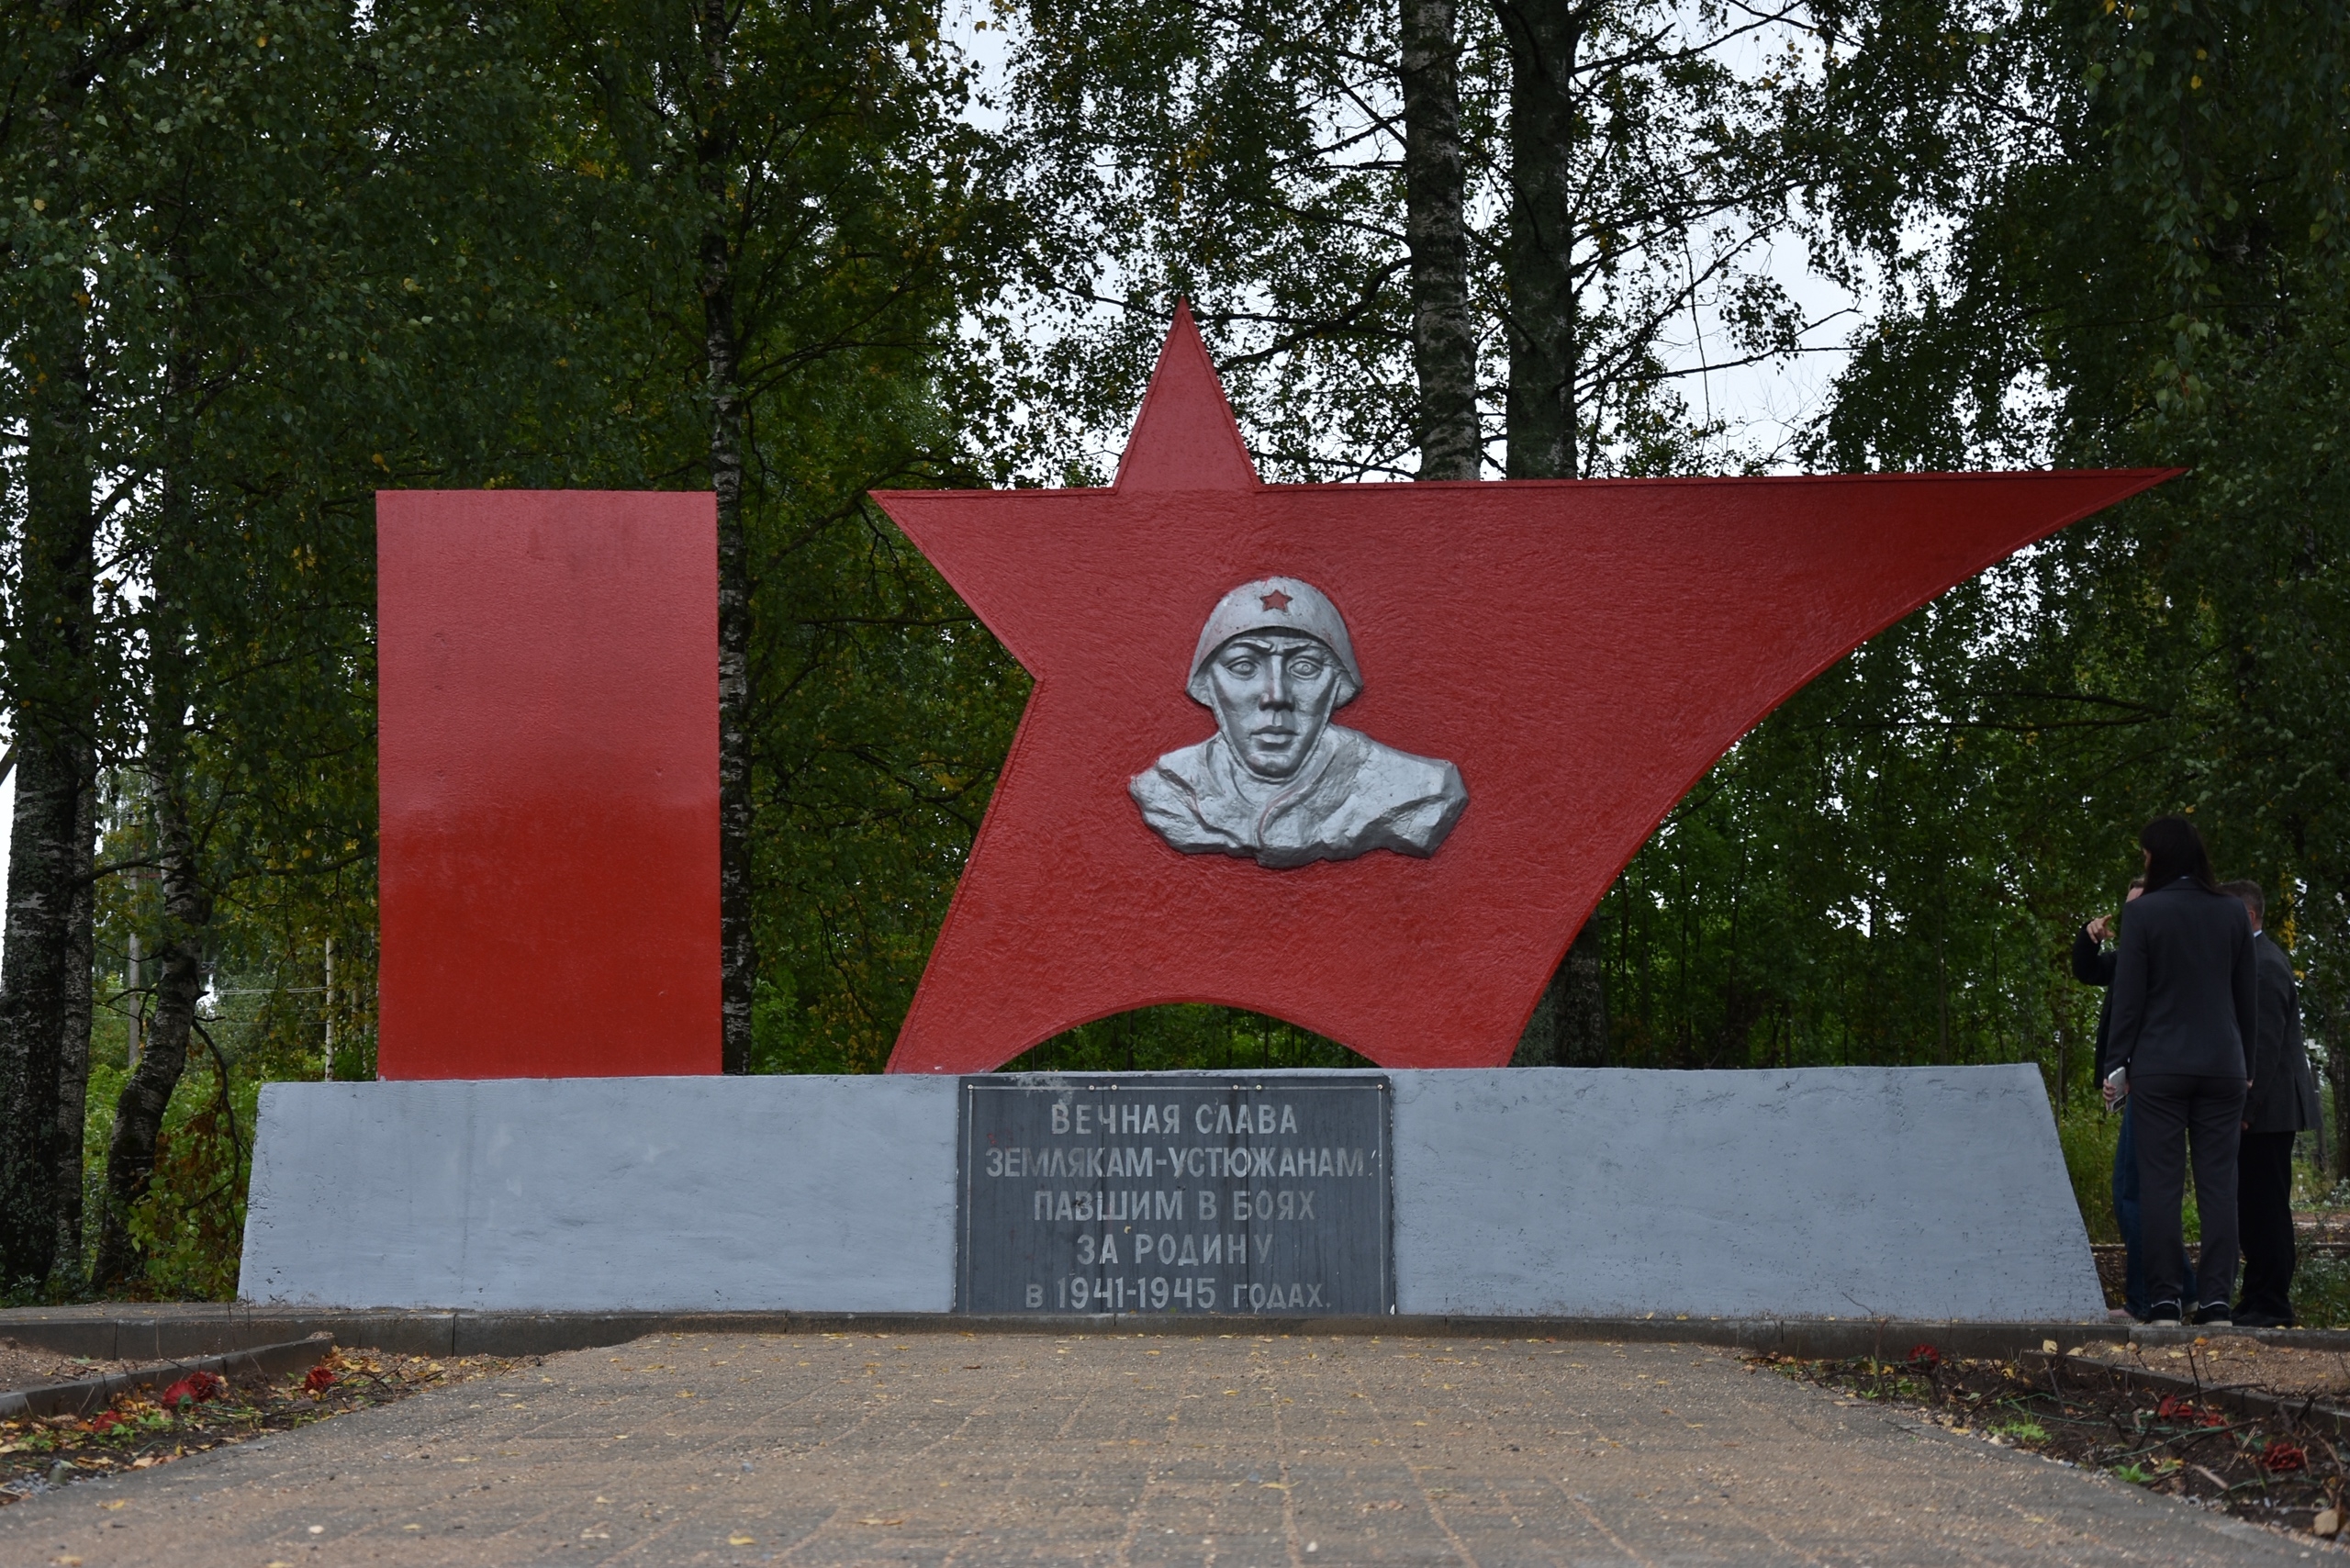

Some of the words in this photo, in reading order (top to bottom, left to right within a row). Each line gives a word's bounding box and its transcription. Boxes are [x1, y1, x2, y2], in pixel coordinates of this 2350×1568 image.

[1051, 1104, 1180, 1135] ВЕЧНАЯ
[1195, 1104, 1298, 1135] СЛАВА
[985, 1147, 1364, 1179] ЗЕМЛЯКАМ-УСТЮЖАНАМ
[1034, 1190, 1183, 1222] ПАВШИМ
[1198, 1191, 1217, 1221] В
[1233, 1190, 1315, 1221] БОЯХ
[1077, 1234, 1119, 1265] ЗА
[1135, 1233, 1273, 1267] РОДИНУ
[1058, 1276, 1216, 1309] 1941-1945
